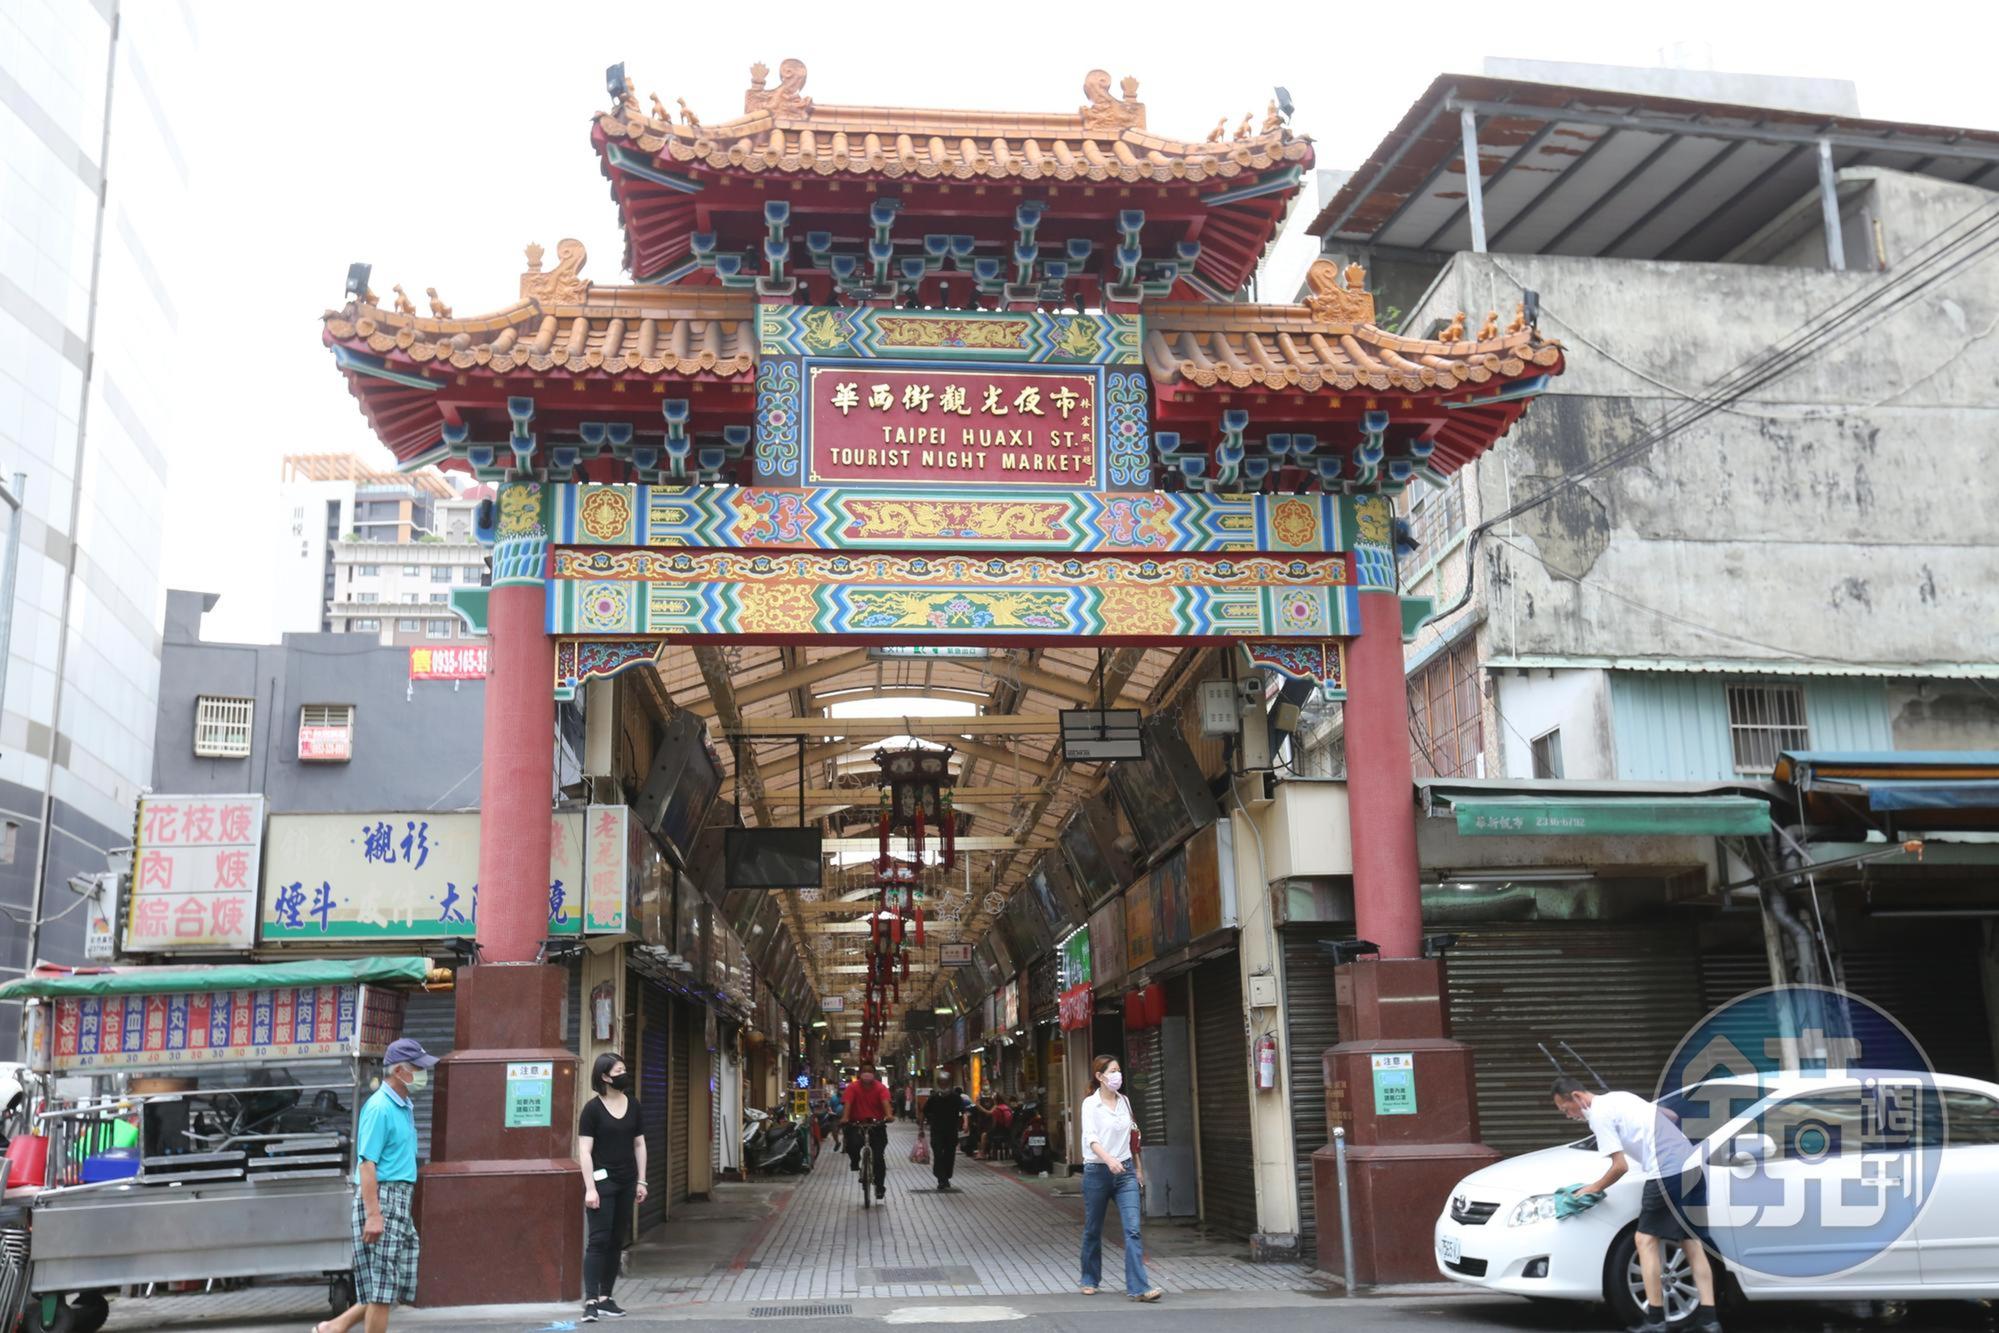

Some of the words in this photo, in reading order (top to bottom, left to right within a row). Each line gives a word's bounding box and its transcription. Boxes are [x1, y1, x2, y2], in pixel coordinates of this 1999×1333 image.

[830, 382, 1080, 419] 華西街觀光夜市
[882, 426, 946, 445] TAIPEI
[962, 428, 1033, 447] HUAXI
[1050, 430, 1079, 448] ST.
[830, 447, 911, 468] TOURIST
[921, 451, 986, 470] NIGHT
[1001, 453, 1082, 472] MARKET
[362, 821, 430, 870] 襯衫
[592, 811, 622, 927] 老花眼鏡
[273, 880, 337, 932] 煙斗
[520, 1066, 539, 1075] 注意
[1384, 1057, 1401, 1066] 注意
